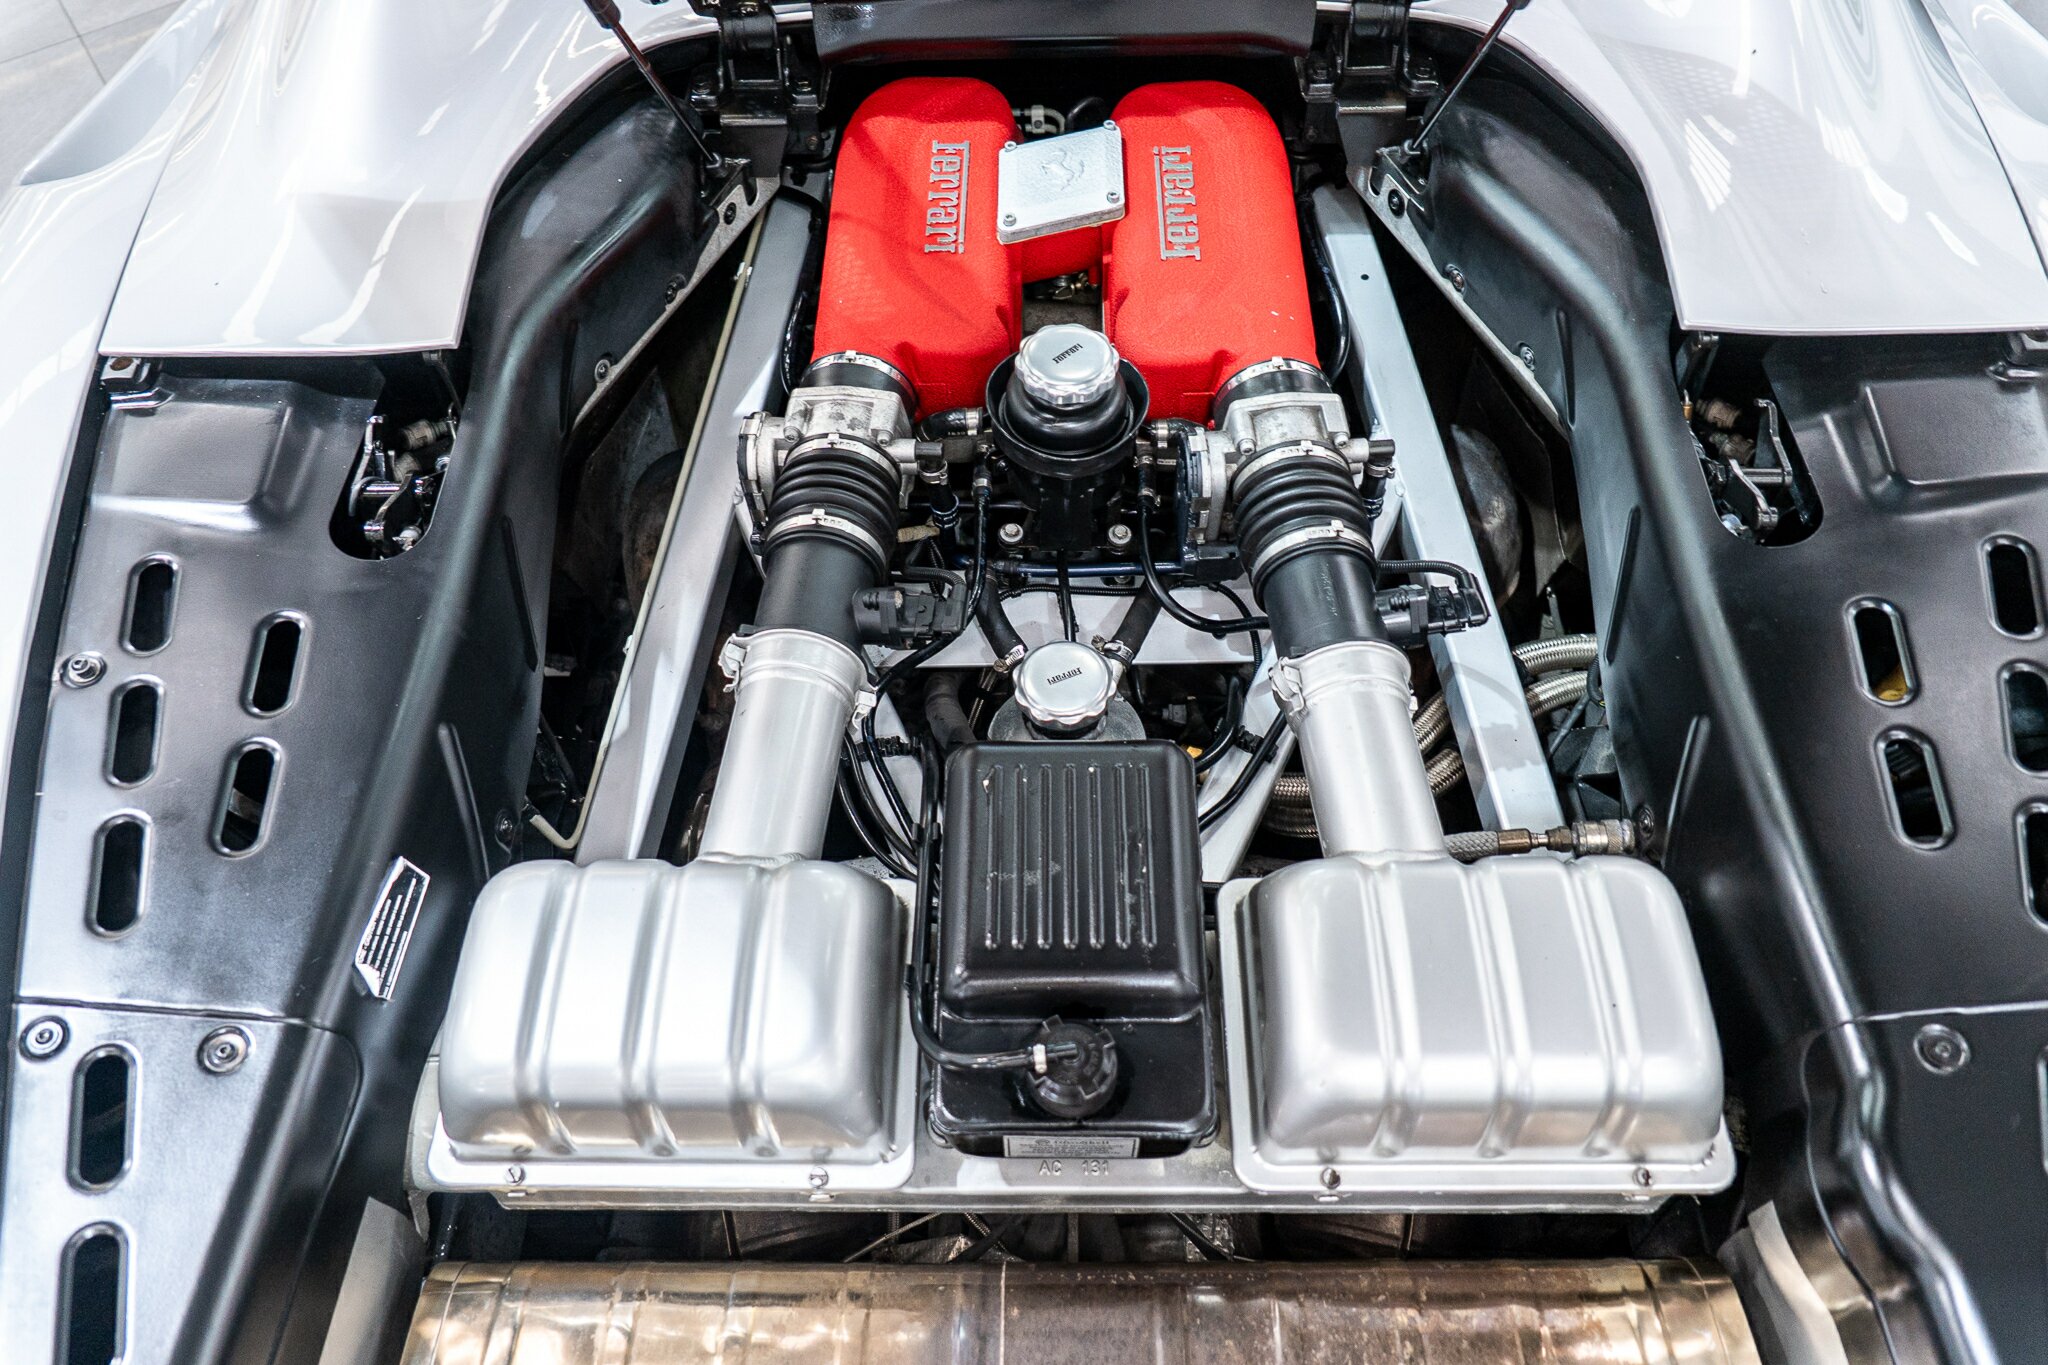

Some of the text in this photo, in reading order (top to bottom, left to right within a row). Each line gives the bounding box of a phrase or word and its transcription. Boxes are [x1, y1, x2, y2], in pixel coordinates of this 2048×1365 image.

[924, 140, 970, 254] Ferrari
[1153, 145, 1201, 261] Ferrari
[1052, 343, 1083, 364] Ferrari
[1047, 667, 1082, 685] Ferrari
[1081, 1159, 1110, 1176] 131
